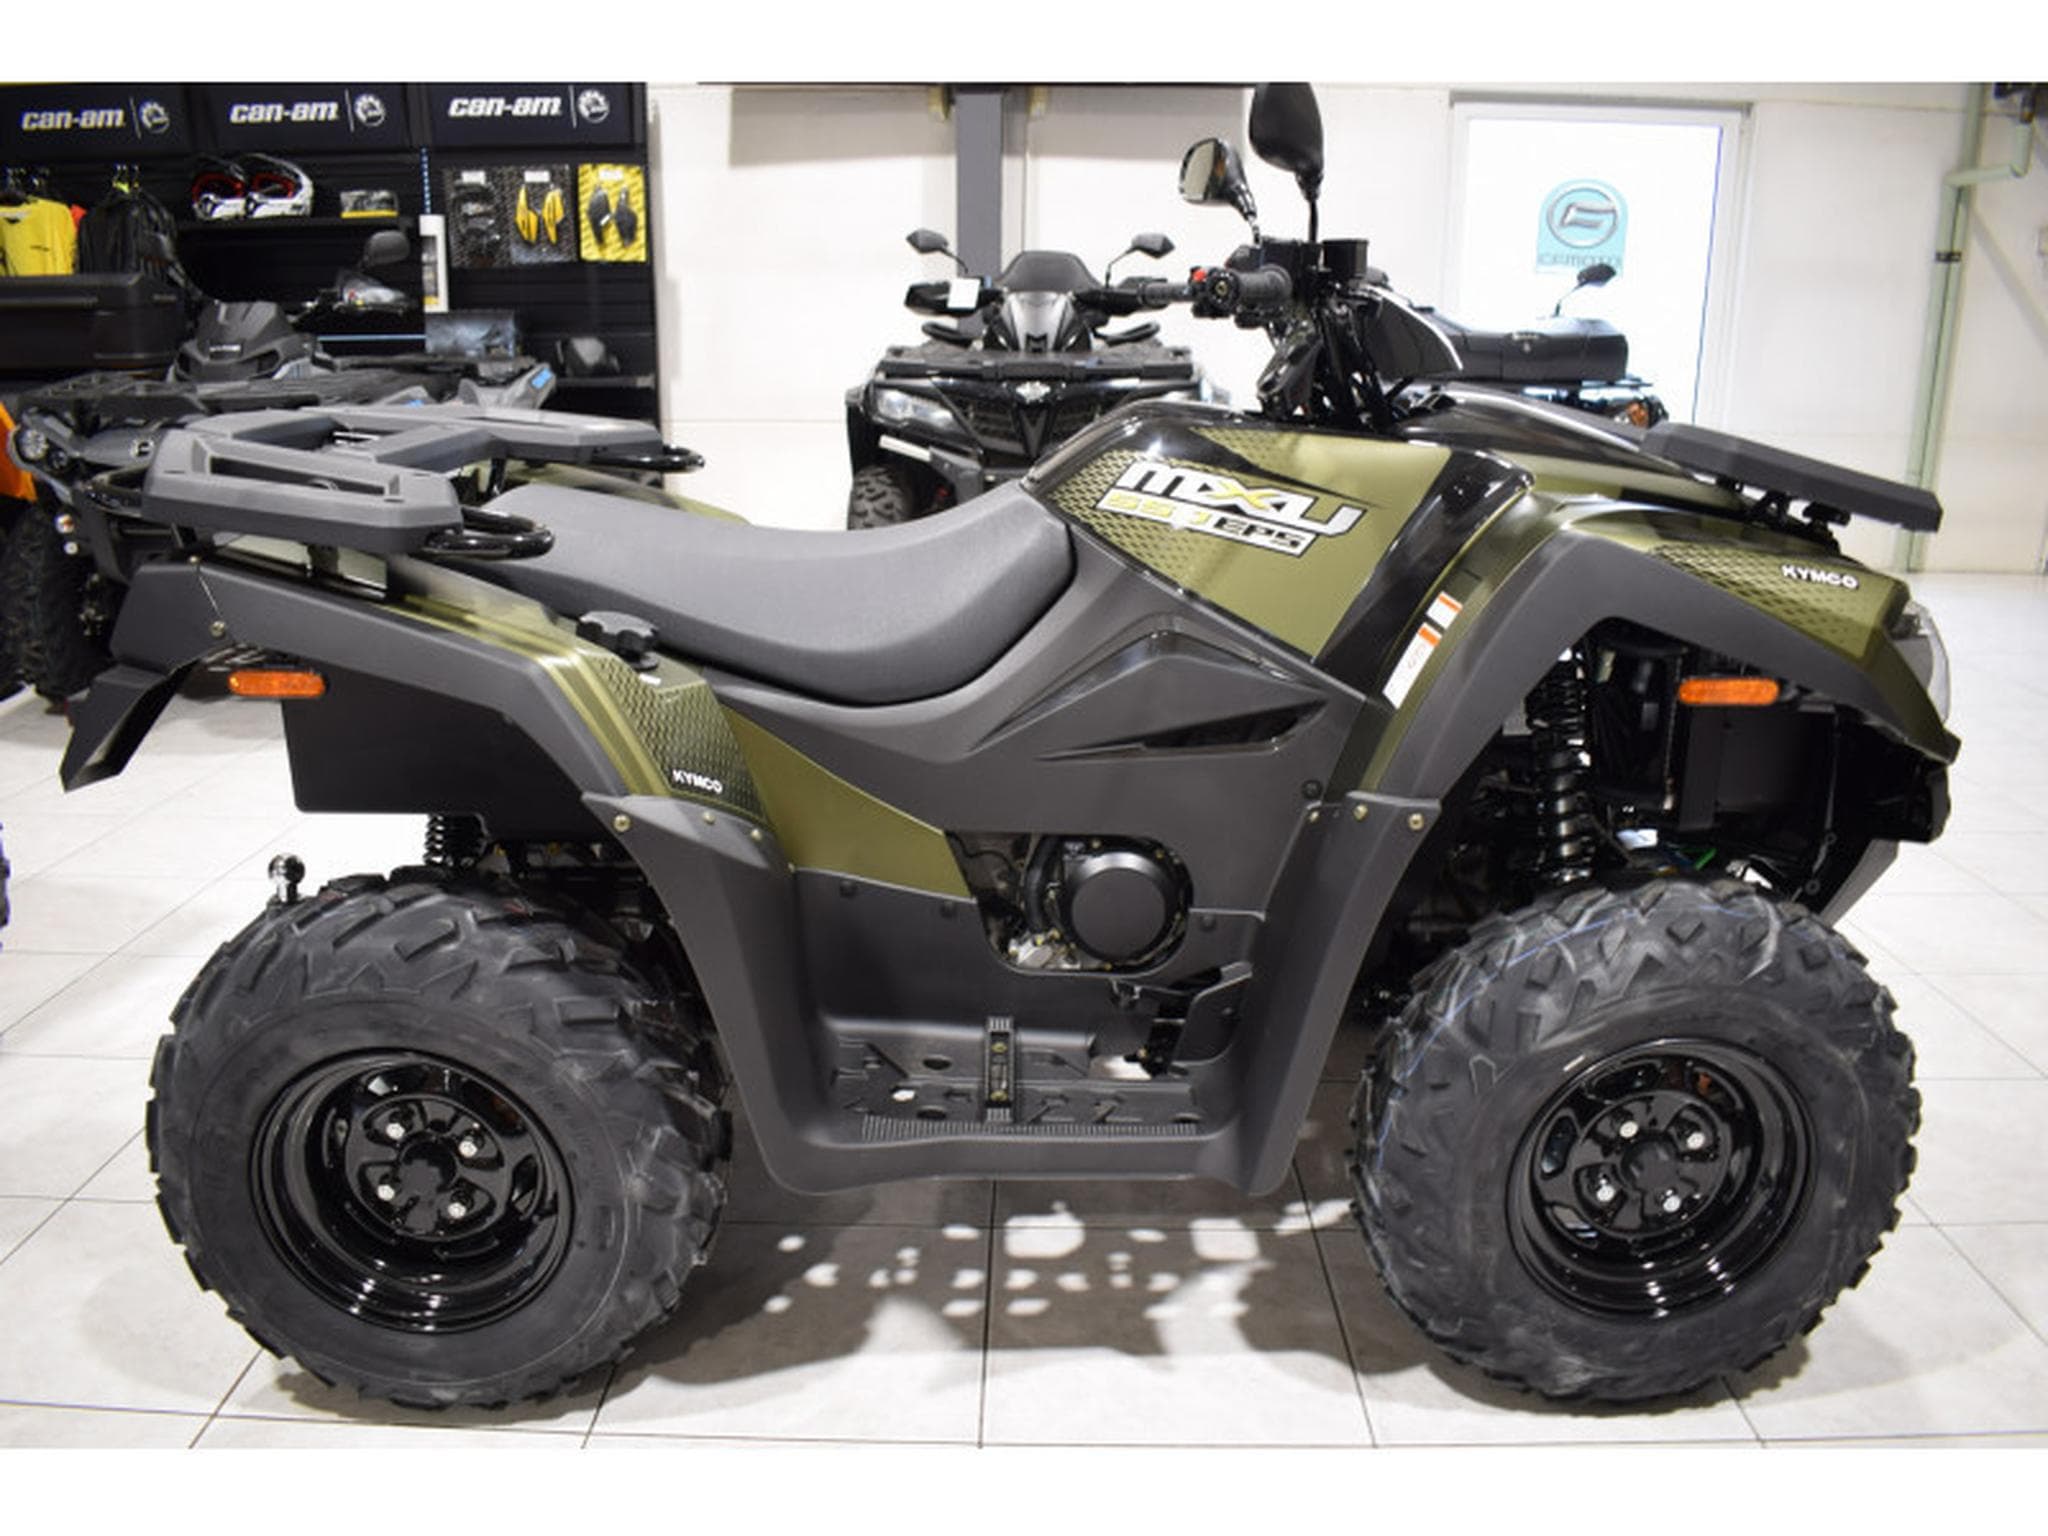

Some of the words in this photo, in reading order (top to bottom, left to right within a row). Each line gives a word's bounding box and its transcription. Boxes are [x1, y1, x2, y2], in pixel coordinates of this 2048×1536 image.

[229, 102, 339, 123] can-am
[447, 97, 561, 117] can-am
[21, 109, 126, 131] can-am
[1213, 516, 1307, 549] EPS
[1781, 564, 1859, 589] KYMCO
[672, 768, 723, 794] KYMCO
